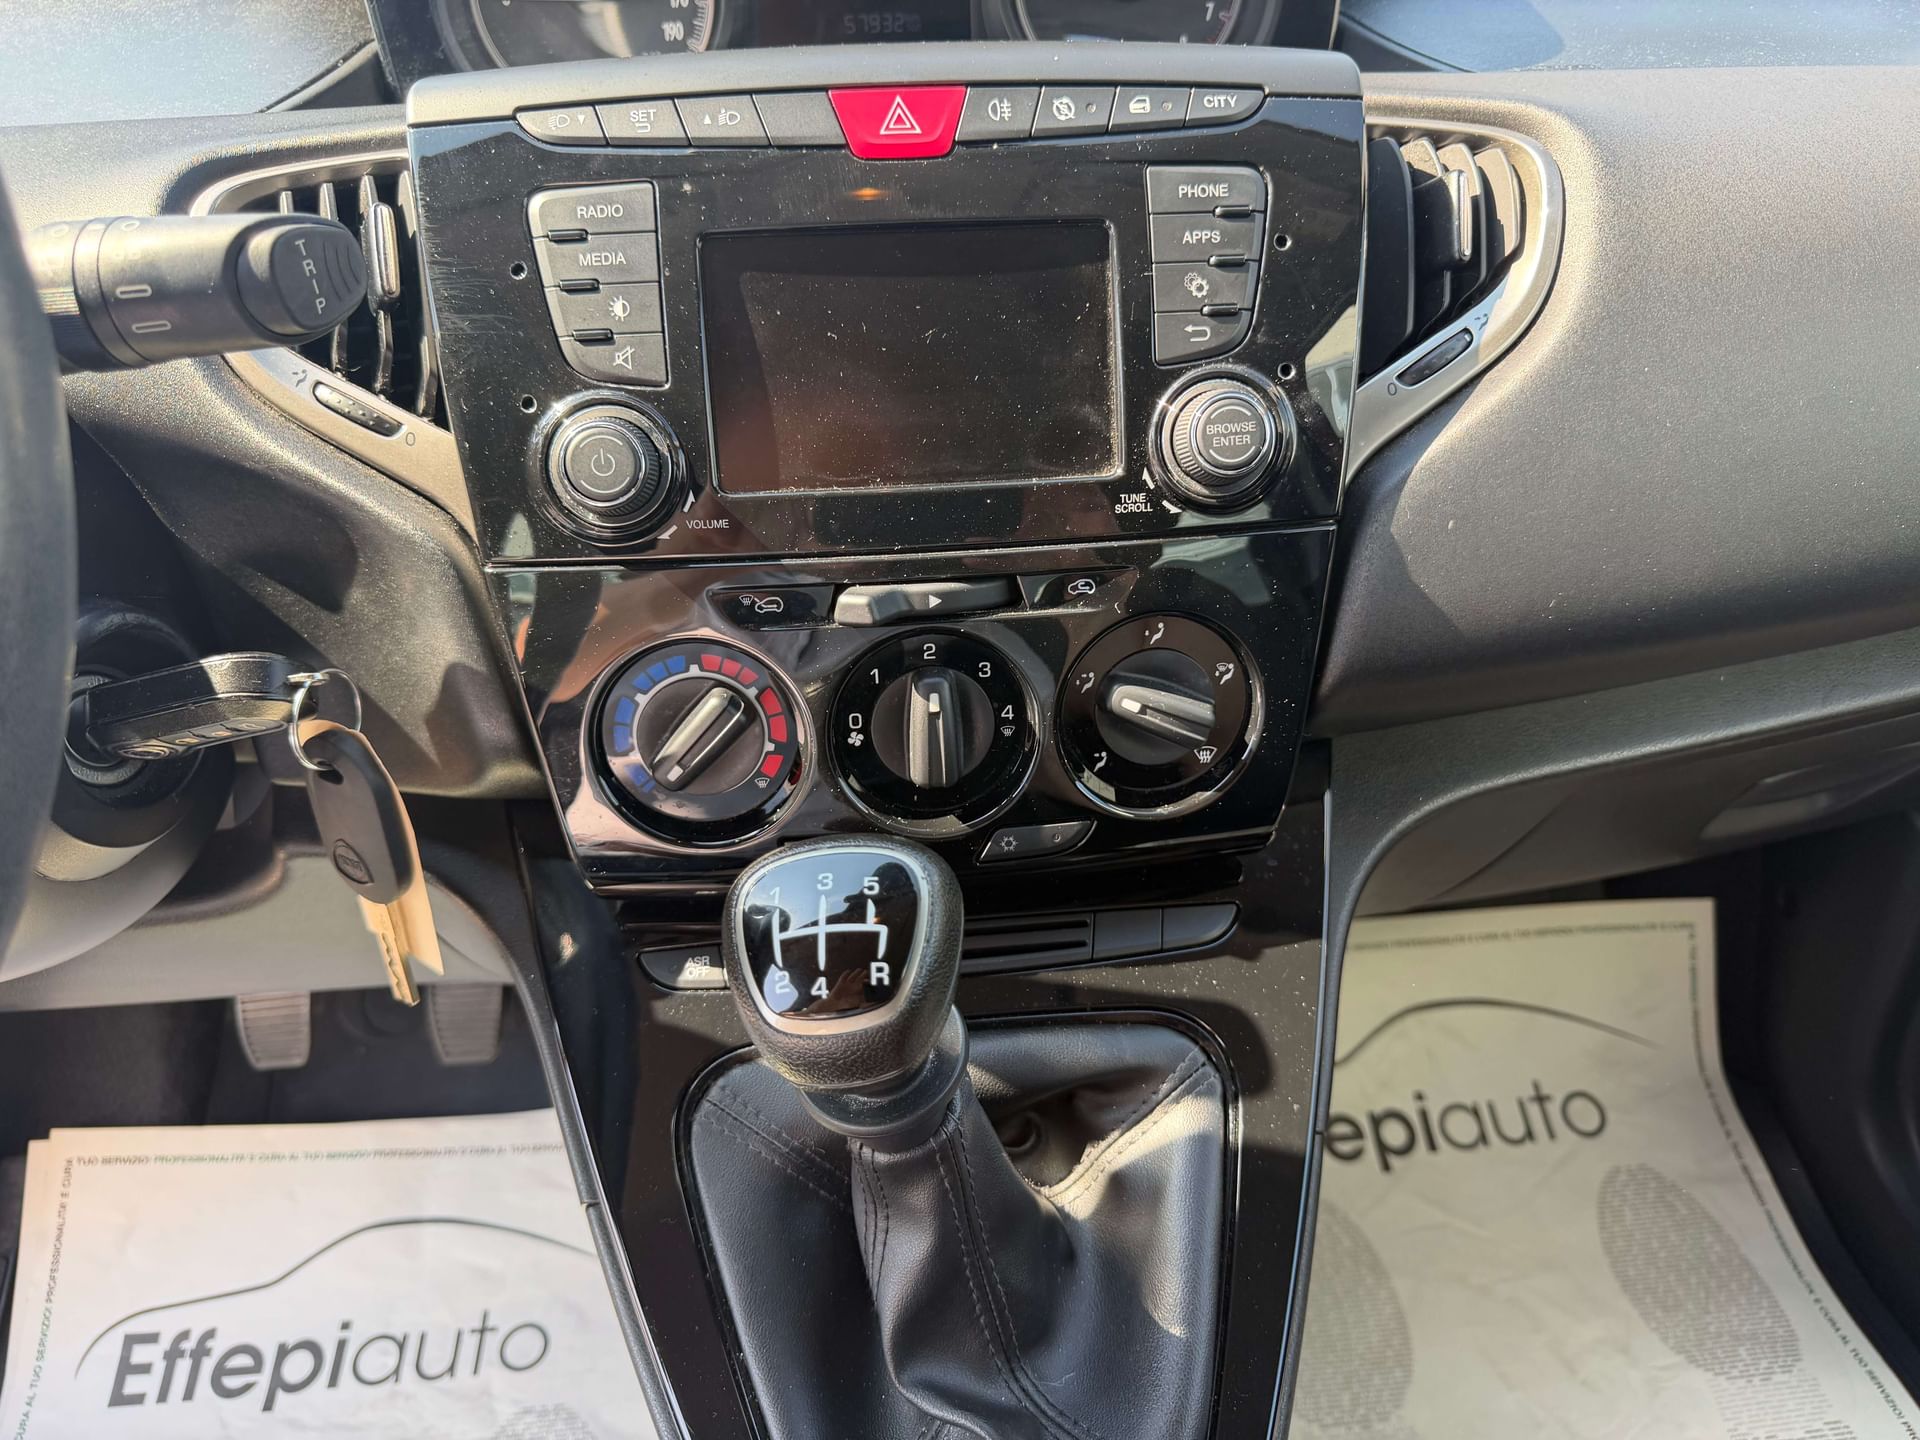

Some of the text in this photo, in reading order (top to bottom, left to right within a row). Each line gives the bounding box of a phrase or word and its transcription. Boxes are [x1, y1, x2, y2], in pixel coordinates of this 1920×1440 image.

[661, 20, 684, 41] 190
[1203, 93, 1238, 109] CITY
[630, 109, 657, 122] SET
[1178, 183, 1229, 199] PHONE
[577, 204, 624, 220] RADIO
[1182, 231, 1221, 245] APPS
[579, 252, 627, 267] MEDIA
[294, 238, 327, 316] TRIP
[1206, 421, 1257, 435] BROWSE
[1212, 434, 1251, 448] ENTER
[1119, 493, 1147, 504] TUNE
[1114, 502, 1153, 514] SCROLL
[686, 518, 730, 530] VOLUME
[923, 643, 936, 659] 2
[870, 668, 880, 685] 1
[978, 661, 992, 678] 3
[1001, 704, 1015, 720] 4
[848, 713, 863, 729] 0
[817, 873, 834, 890] 3
[863, 877, 880, 896] 5
[769, 886, 781, 904] 1
[686, 955, 710, 967] ASR
[687, 966, 710, 977] OFF
[870, 961, 890, 986] R
[774, 970, 791, 994] 2
[810, 977, 829, 999] 4
[107, 1310, 552, 1412] Effepiauto
